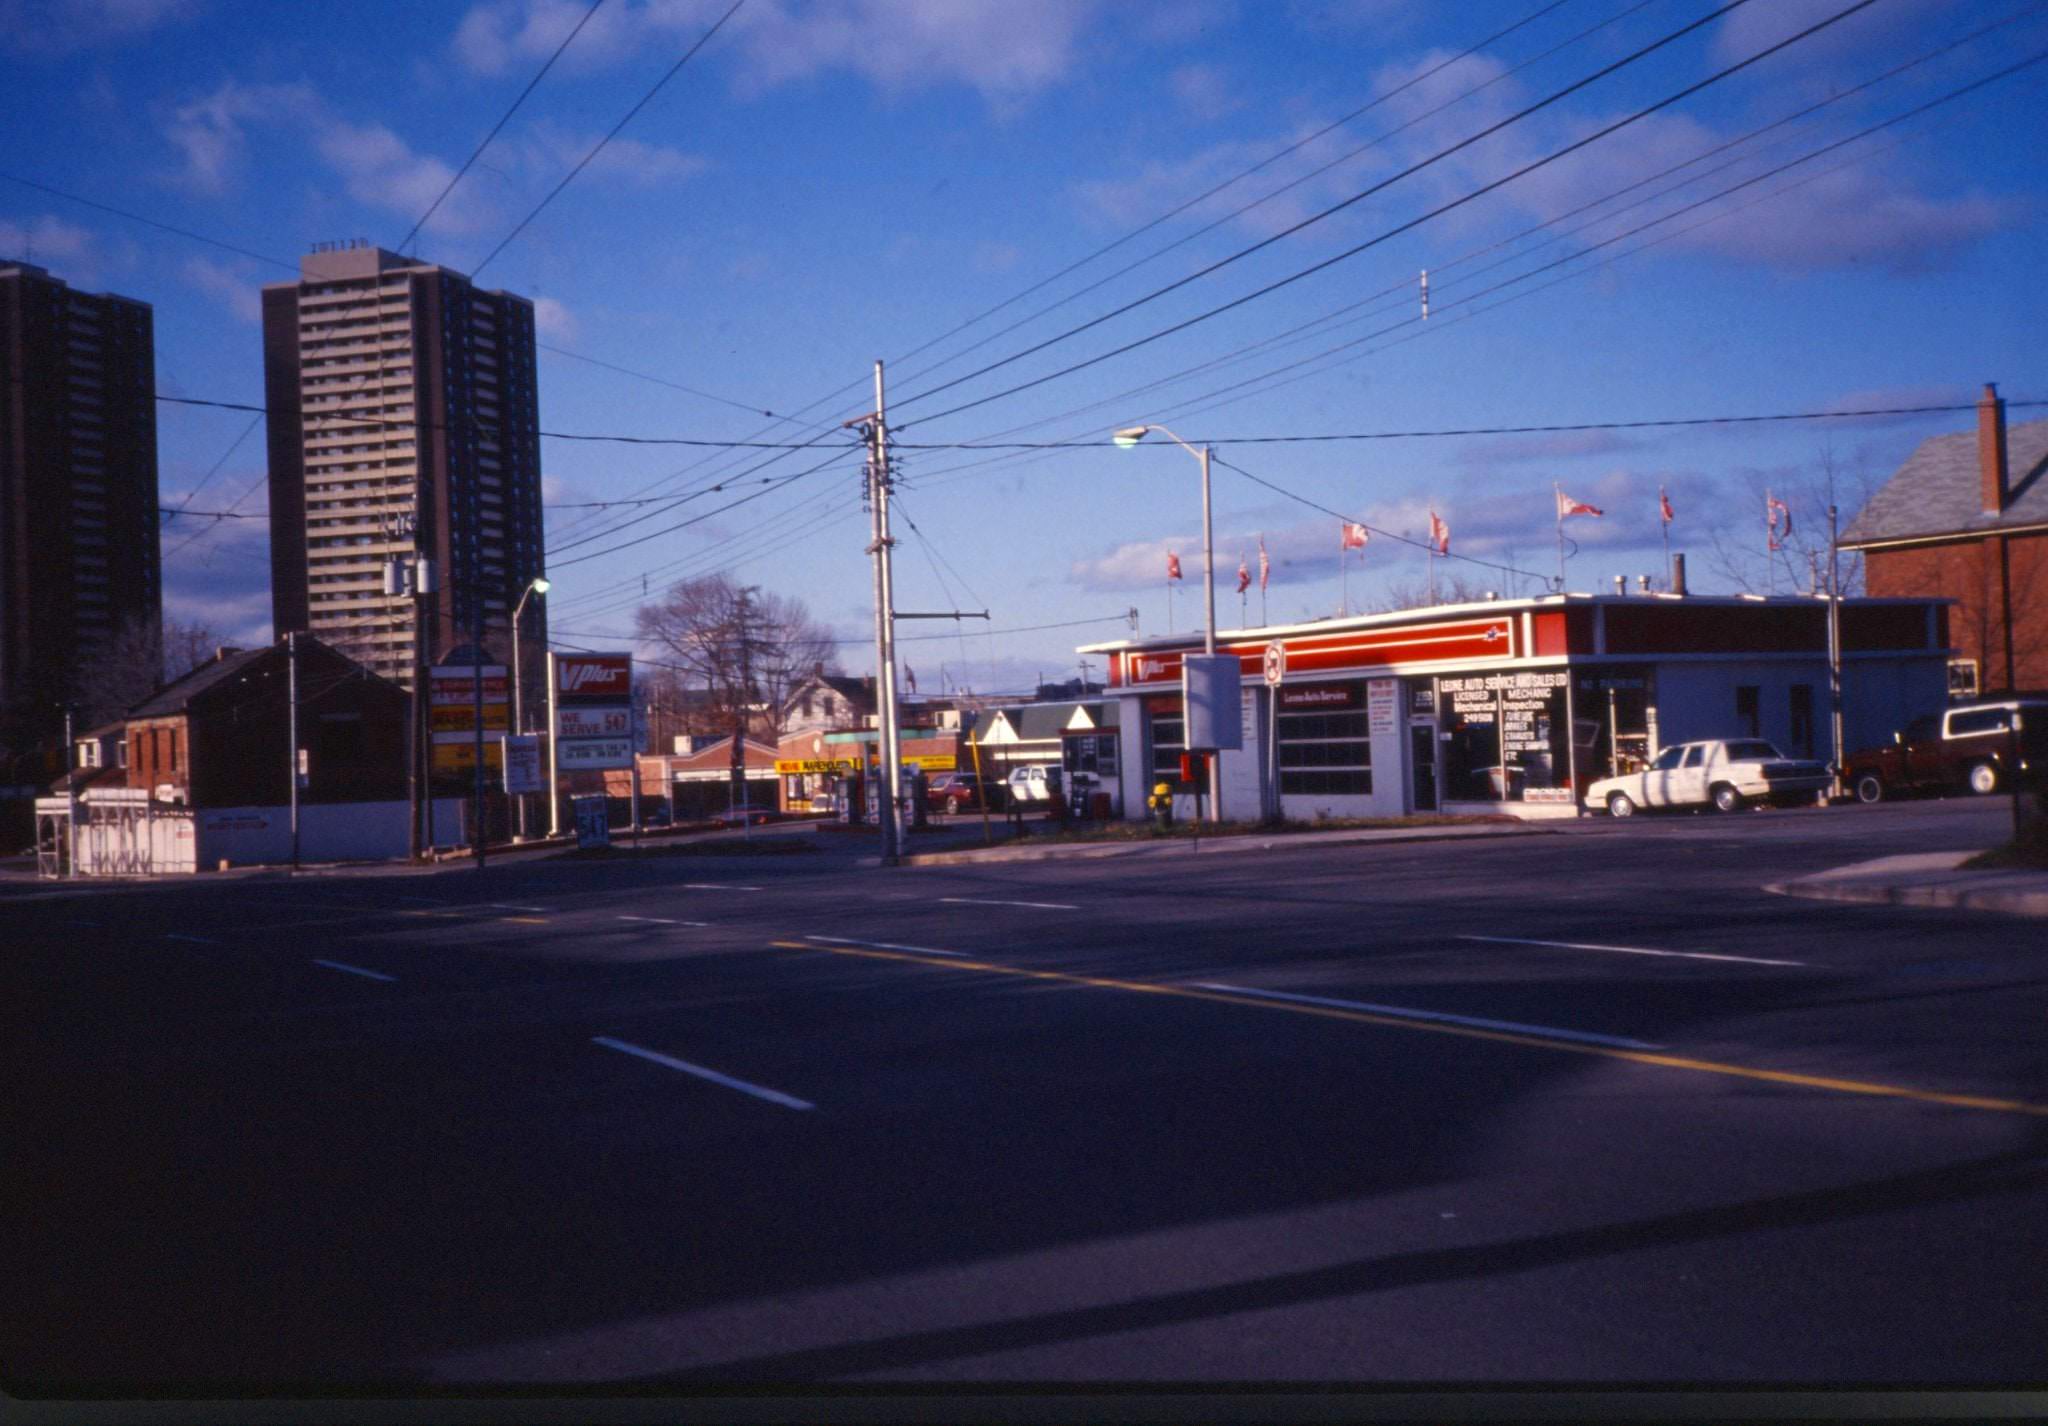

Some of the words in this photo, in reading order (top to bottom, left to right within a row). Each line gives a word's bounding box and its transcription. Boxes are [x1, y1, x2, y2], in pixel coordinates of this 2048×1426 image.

[1464, 678, 1485, 690] AUTO
[1485, 676, 1515, 690] SERVICE
[1533, 673, 1555, 688] SALES
[1454, 691, 1489, 701] LICENSED
[1508, 688, 1552, 699] MECHANIC
[560, 712, 579, 722] WE
[561, 723, 601, 735] SERVE
